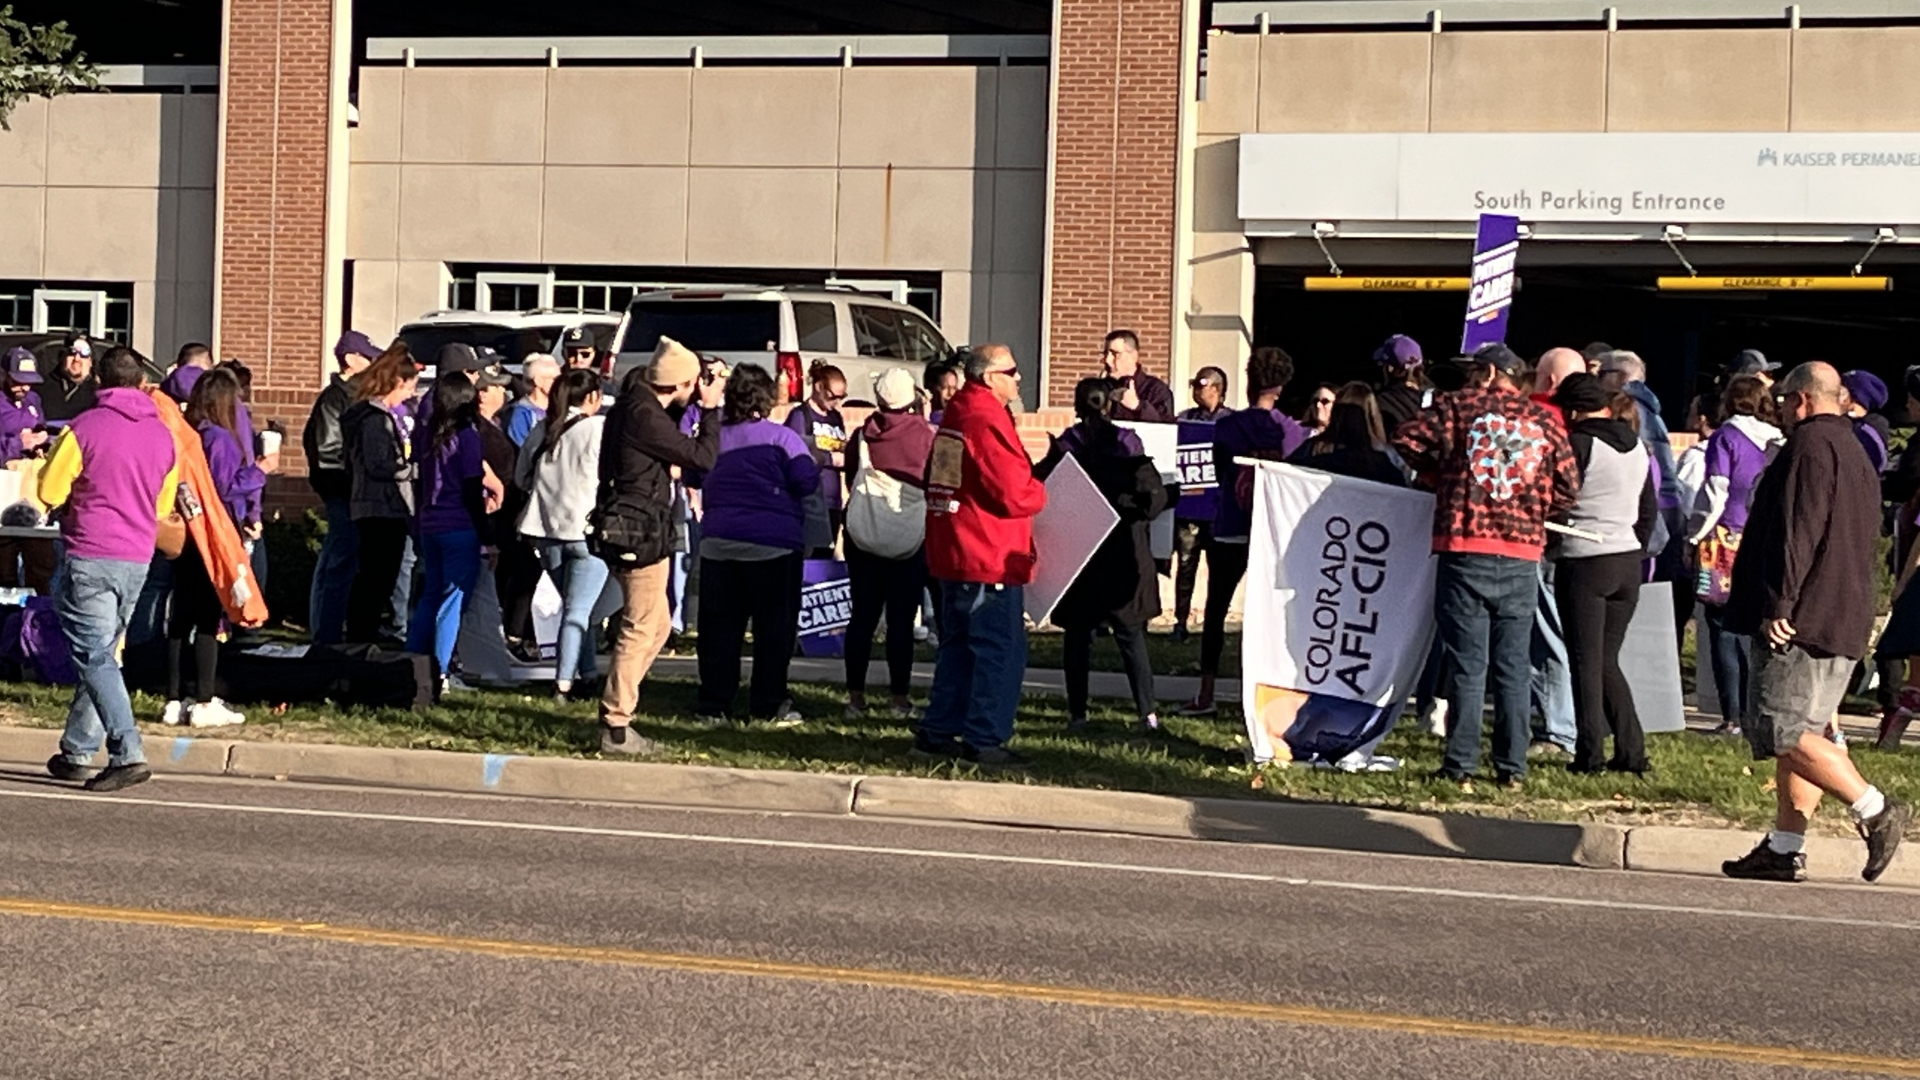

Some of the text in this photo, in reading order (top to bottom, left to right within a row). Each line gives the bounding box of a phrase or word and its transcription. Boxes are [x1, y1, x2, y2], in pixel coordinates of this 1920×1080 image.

[1783, 152, 1920, 166] KAISER PERMANE
[1474, 190, 1725, 215] South Parking Entrance
[1361, 279, 1417, 289] CLEARANCE
[1722, 278, 1781, 288] CLEARANCE
[801, 585, 851, 608] ATIENT
[1305, 516, 1350, 685] COLORADO
[1335, 521, 1390, 696] AFL-CIO
